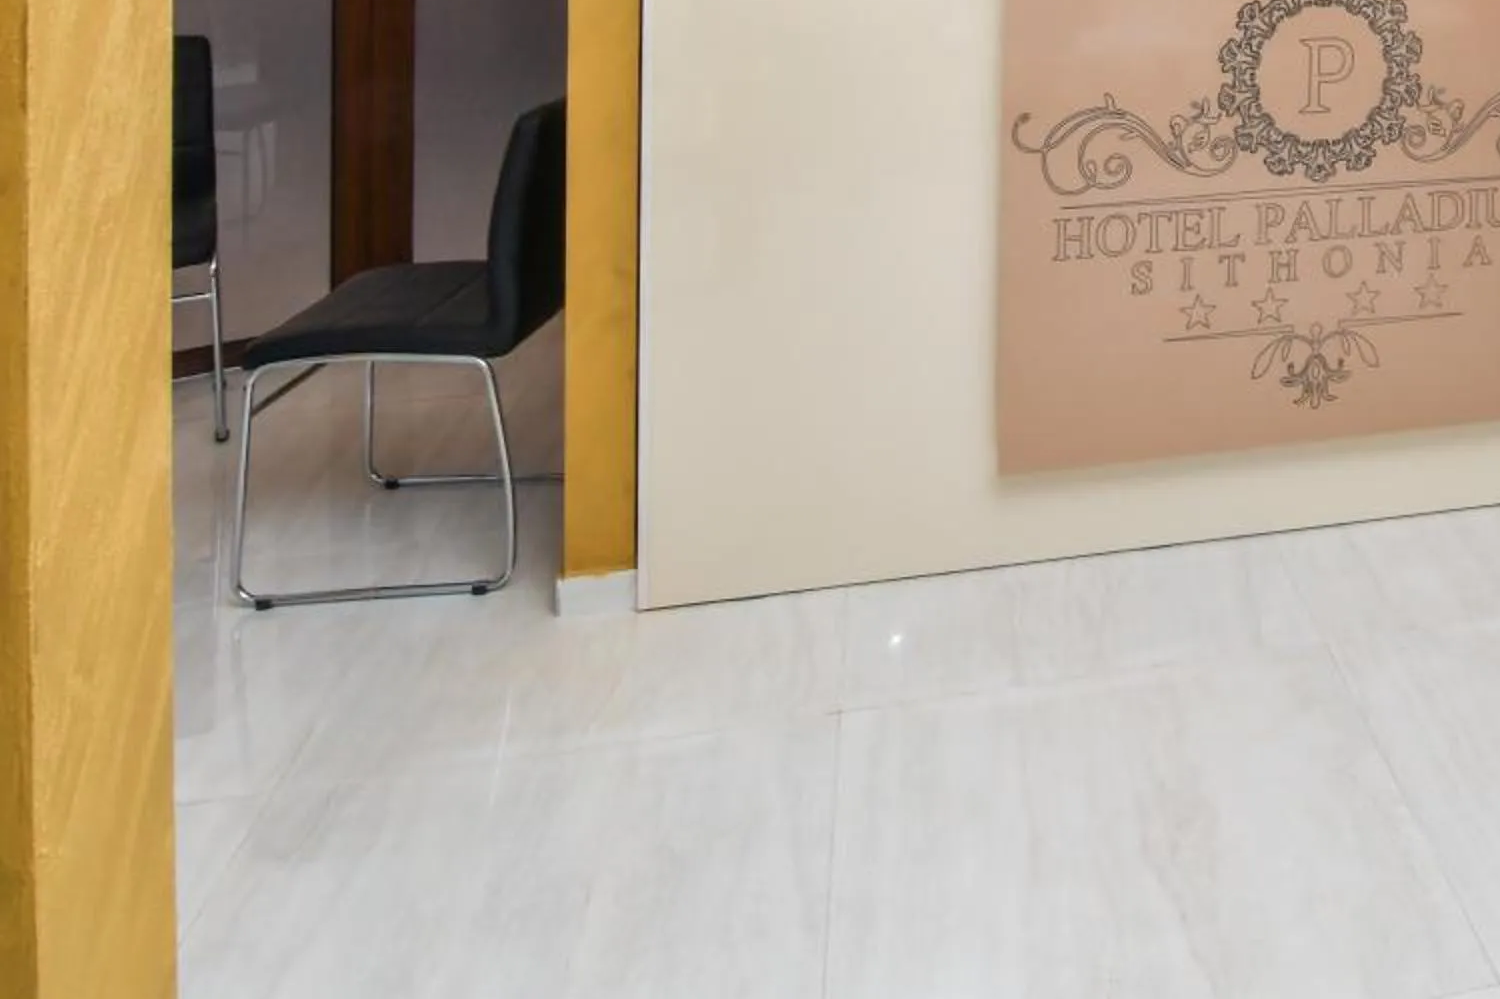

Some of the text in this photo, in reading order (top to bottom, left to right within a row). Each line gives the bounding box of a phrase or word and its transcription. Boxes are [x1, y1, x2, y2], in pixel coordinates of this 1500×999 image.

[1299, 37, 1355, 114] P
[1051, 205, 1241, 262] HOTEL
[1131, 235, 1493, 296] SITHONIA
